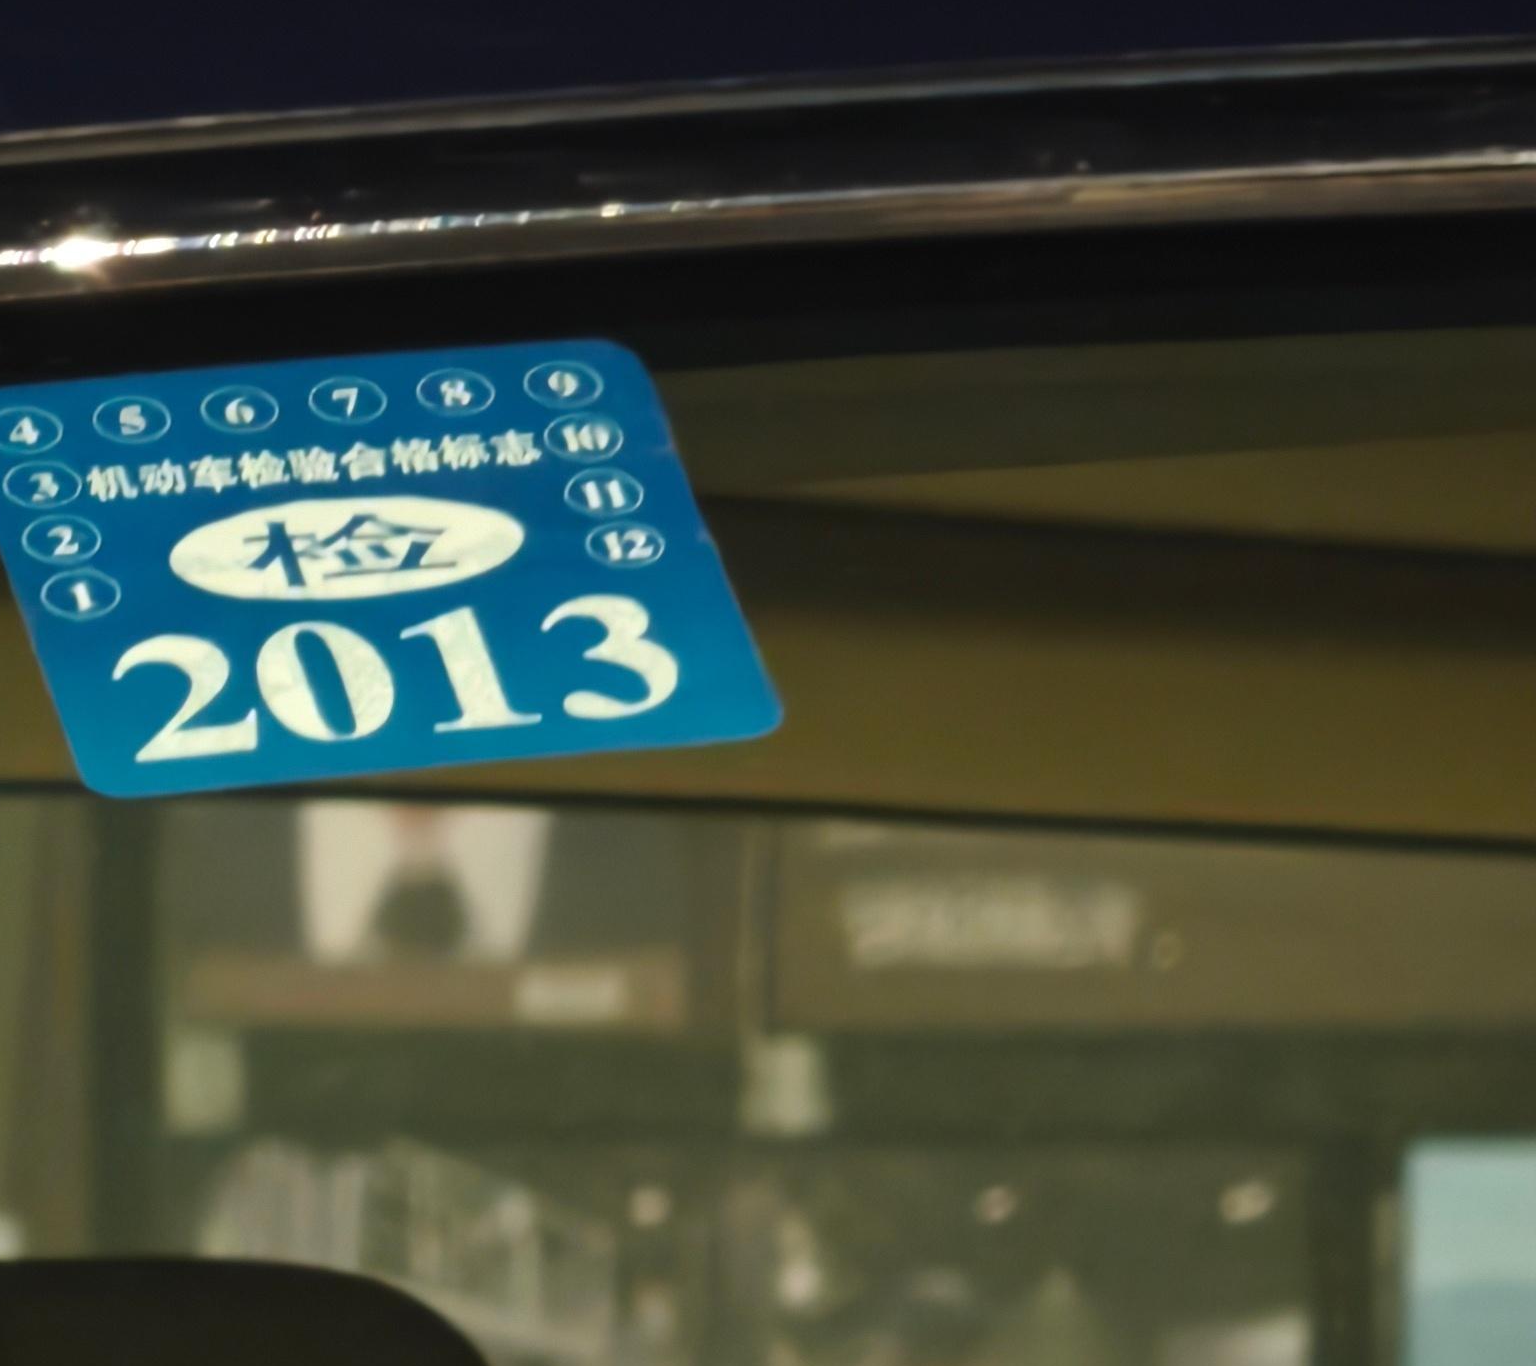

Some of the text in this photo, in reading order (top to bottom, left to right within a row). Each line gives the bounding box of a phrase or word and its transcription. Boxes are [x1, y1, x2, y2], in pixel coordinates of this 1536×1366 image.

[9, 370, 579, 446] 4 5 6 7 8 9
[562, 423, 611, 453] 10
[86, 428, 542, 503] 机动车检验合格标志
[29, 471, 59, 503] 3
[581, 479, 626, 510] 11
[47, 525, 80, 556] 2
[243, 513, 458, 588] 检
[603, 528, 654, 561] 12
[111, 594, 681, 763] 2013
